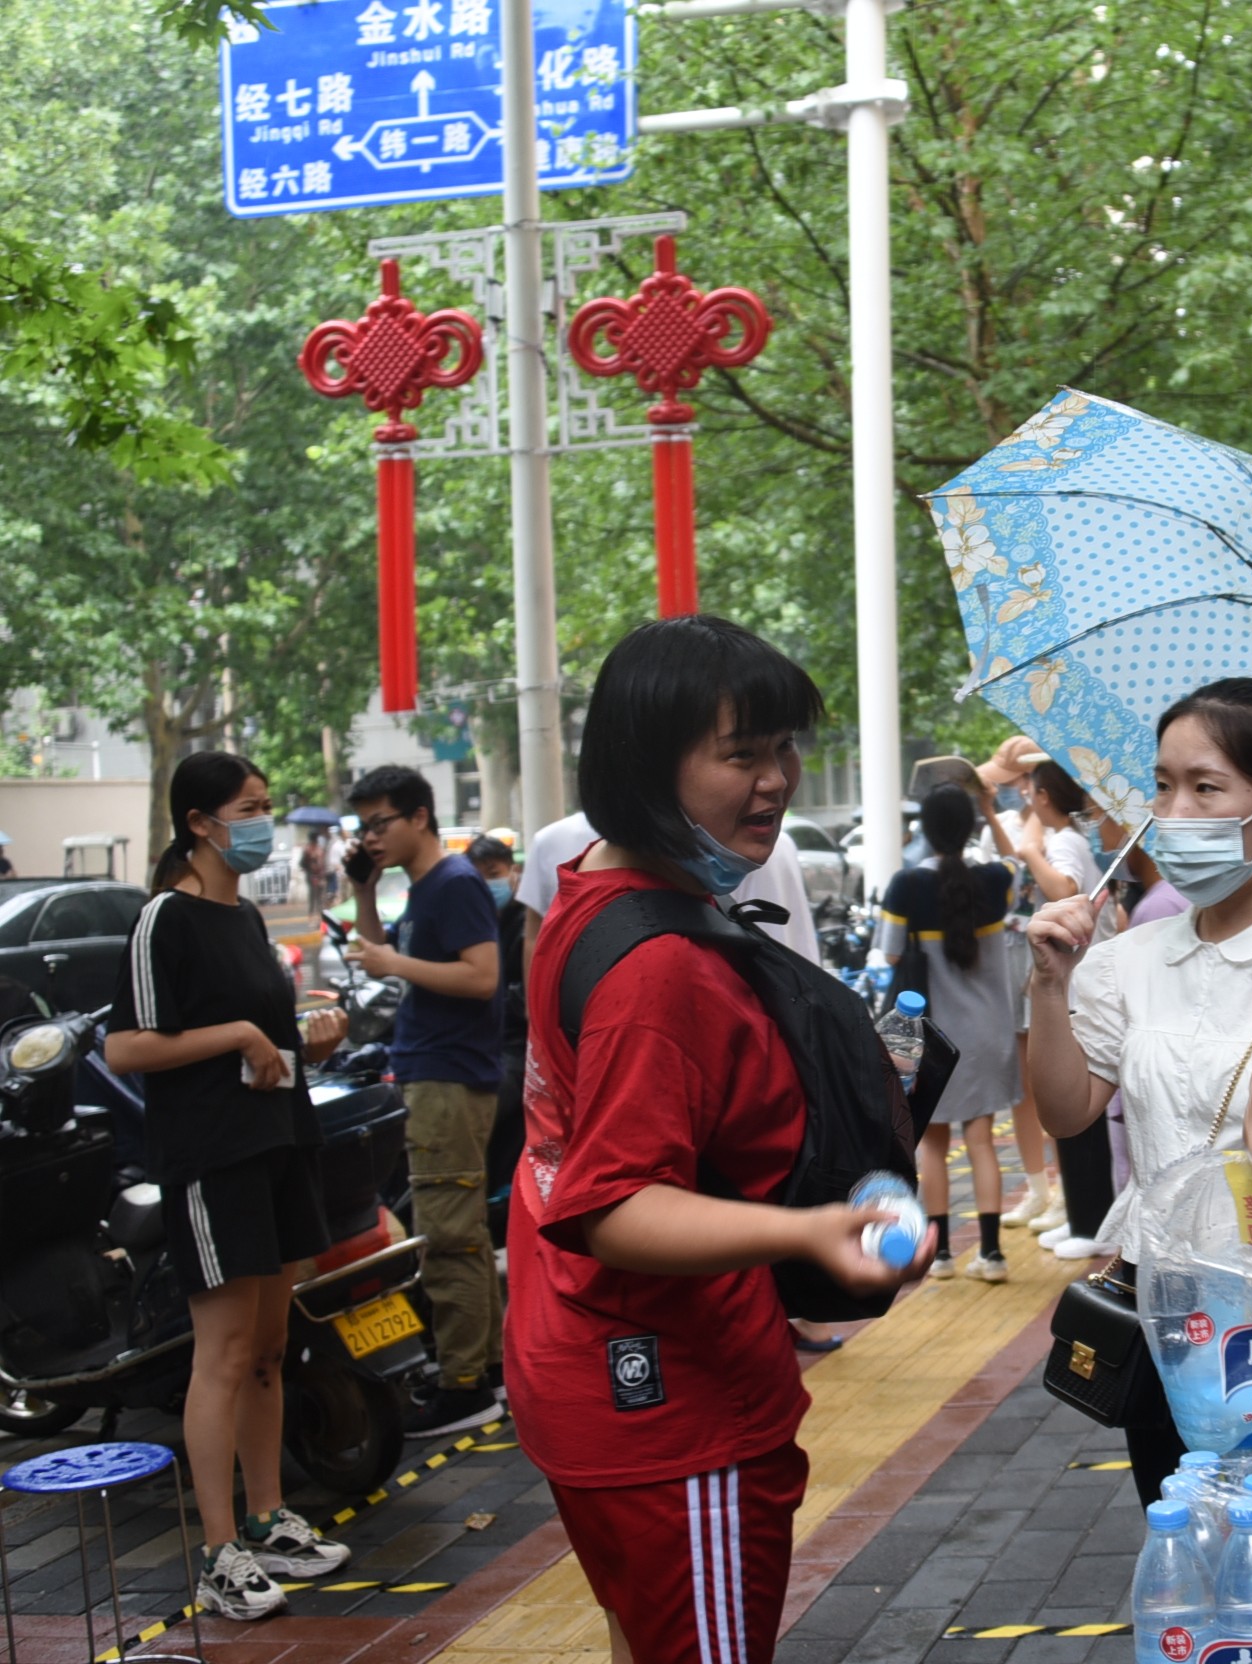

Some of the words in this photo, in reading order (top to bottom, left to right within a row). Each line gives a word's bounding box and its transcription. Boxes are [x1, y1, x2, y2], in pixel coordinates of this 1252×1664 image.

[355, 0, 493, 45] 金水路
[366, 44, 442, 69] Jinshui
[450, 41, 476, 59] Rd
[494, 43, 620, 94] 化路
[235, 72, 354, 122] 经七路
[249, 121, 310, 144] Jingqi
[318, 119, 343, 136] Rd
[379, 121, 472, 160] 纬一路
[238, 161, 334, 200] 经六路
[347, 1310, 417, 1352] 2112792
[1167, 1645, 1188, 1656] 上市
